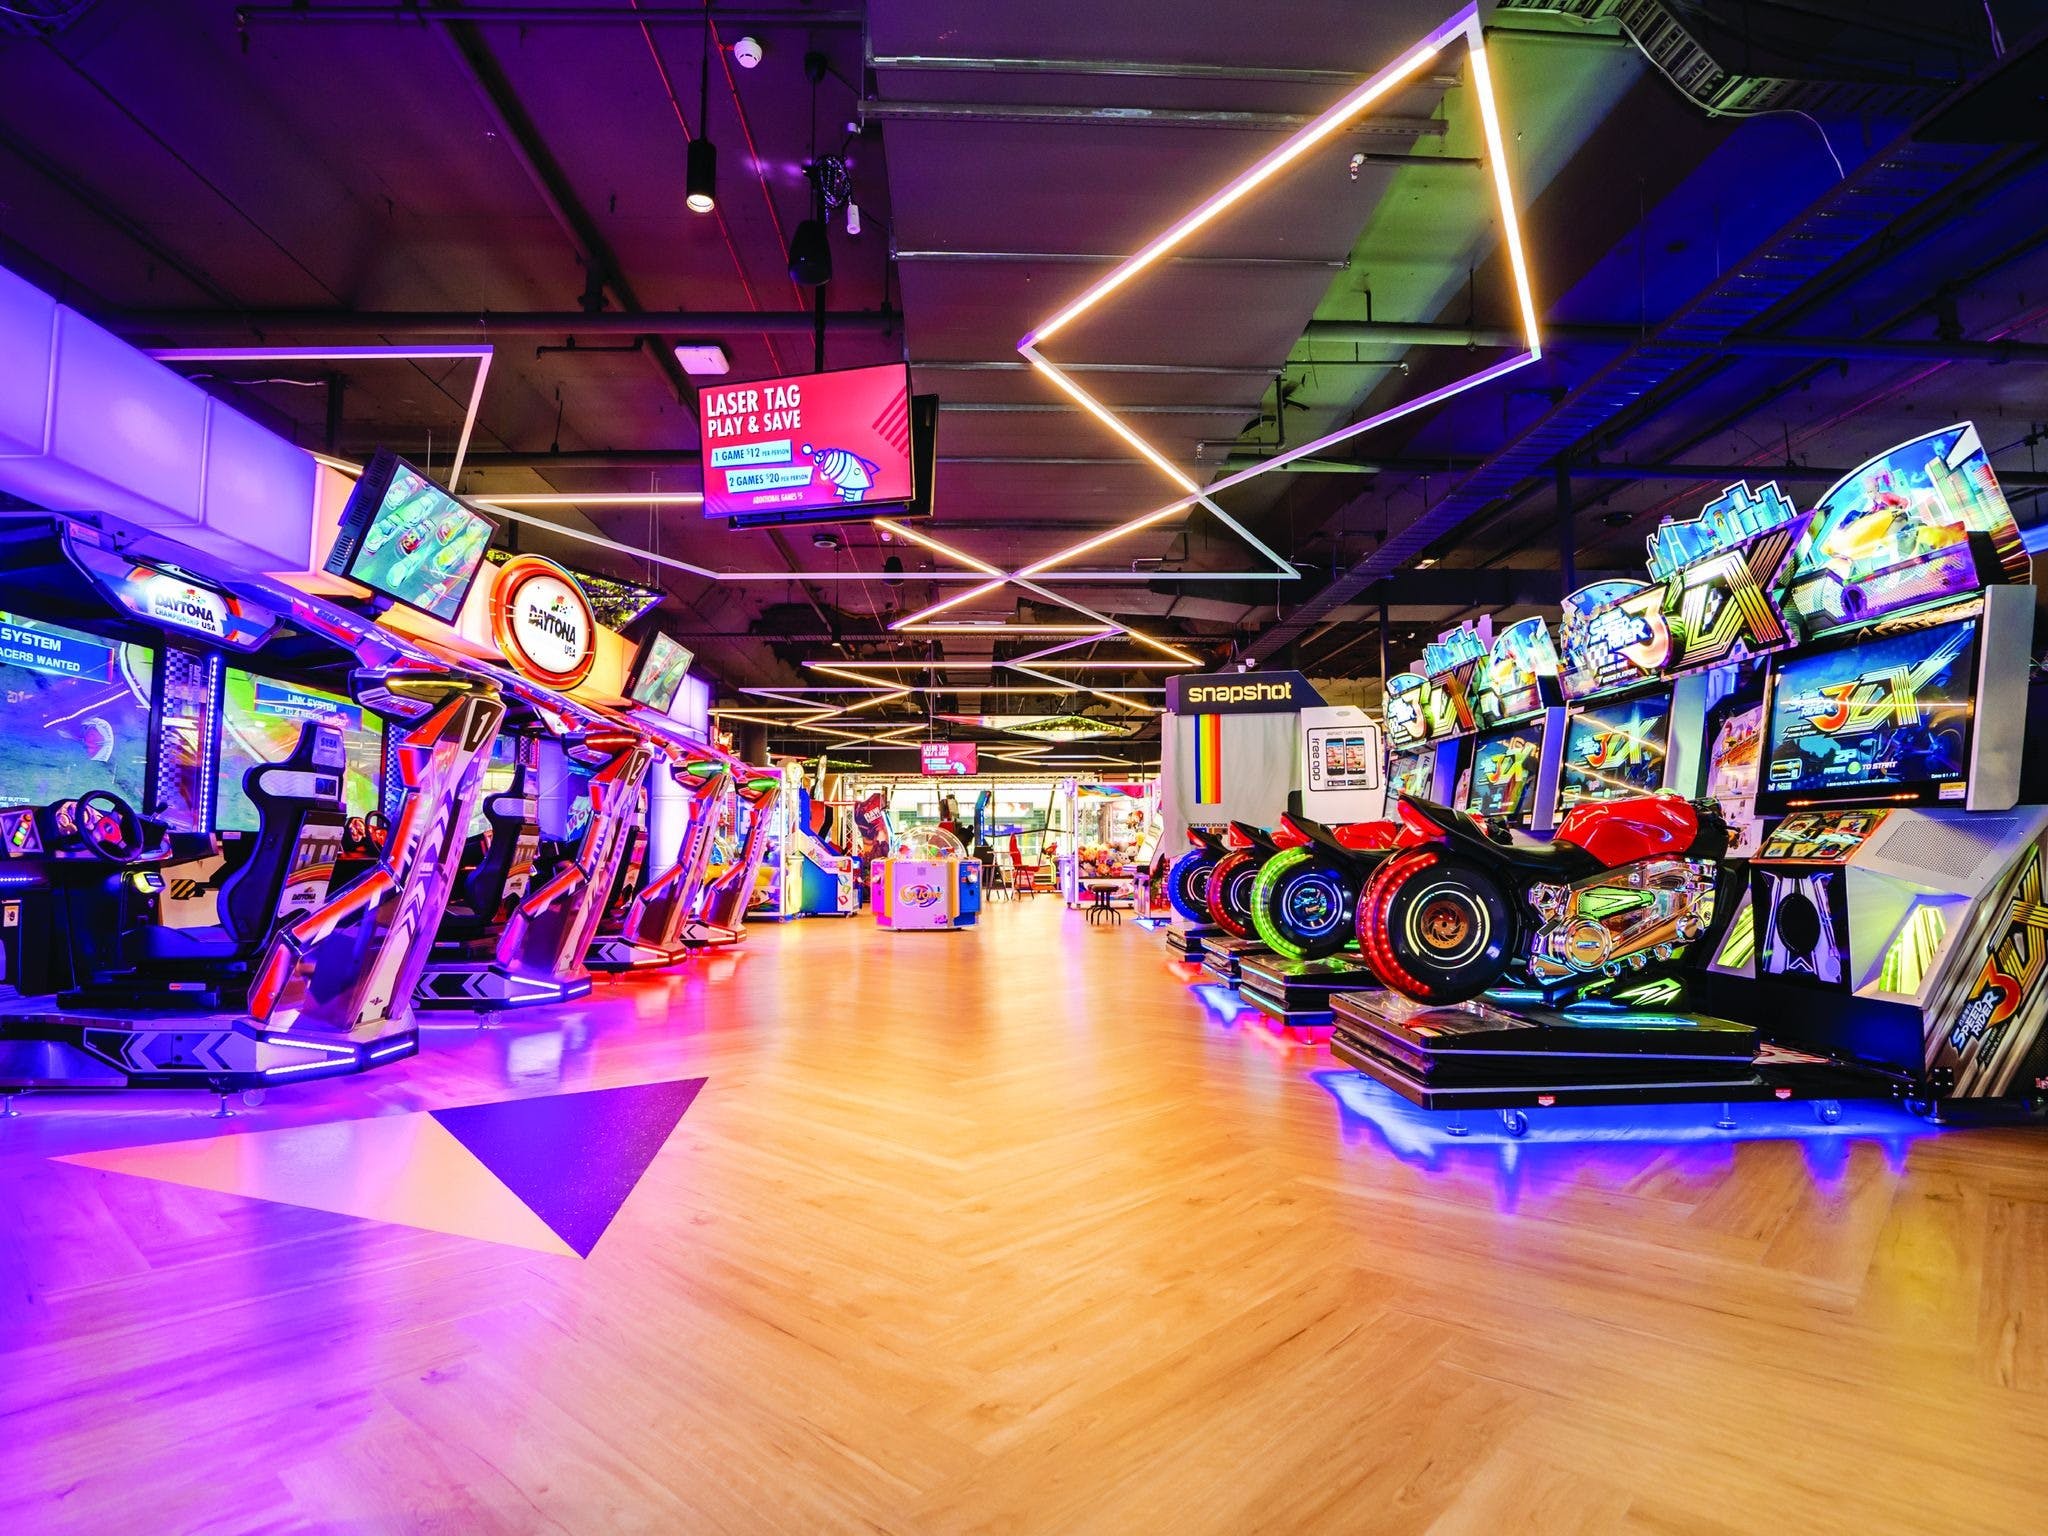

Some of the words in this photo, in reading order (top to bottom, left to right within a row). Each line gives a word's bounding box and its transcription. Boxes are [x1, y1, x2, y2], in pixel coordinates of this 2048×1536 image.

[706, 391, 759, 417] LASER
[764, 384, 800, 410] TAG
[707, 416, 744, 438] PLAY
[747, 415, 759, 433] &
[763, 410, 801, 432] SAVE
[714, 452, 719, 461] 1
[722, 449, 744, 461] GAME
[746, 447, 760, 458] $12
[729, 477, 734, 486] 2
[736, 474, 764, 486] GAMES
[765, 473, 779, 483] $20
[155, 595, 215, 623] DAYTONA
[1616, 585, 1669, 669] 3
[1675, 529, 1791, 669] DX
[201, 621, 216, 631] USA
[528, 604, 576, 645] DAYTONA
[1, 627, 61, 652] SYSTEM
[36, 655, 80, 672] WANTED
[1188, 682, 1292, 703] snapshot
[1811, 681, 1860, 732] 3
[473, 711, 491, 743] 1
[1311, 737, 1320, 759] free
[1834, 748, 1858, 764] 2P
[631, 757, 645, 780] 2
[1312, 760, 1320, 781] app
[1872, 761, 1898, 770] START
[1969, 952, 2022, 1028] 3
[1952, 1000, 1983, 1049] SPEED
[1971, 991, 1999, 1037] RIDER
